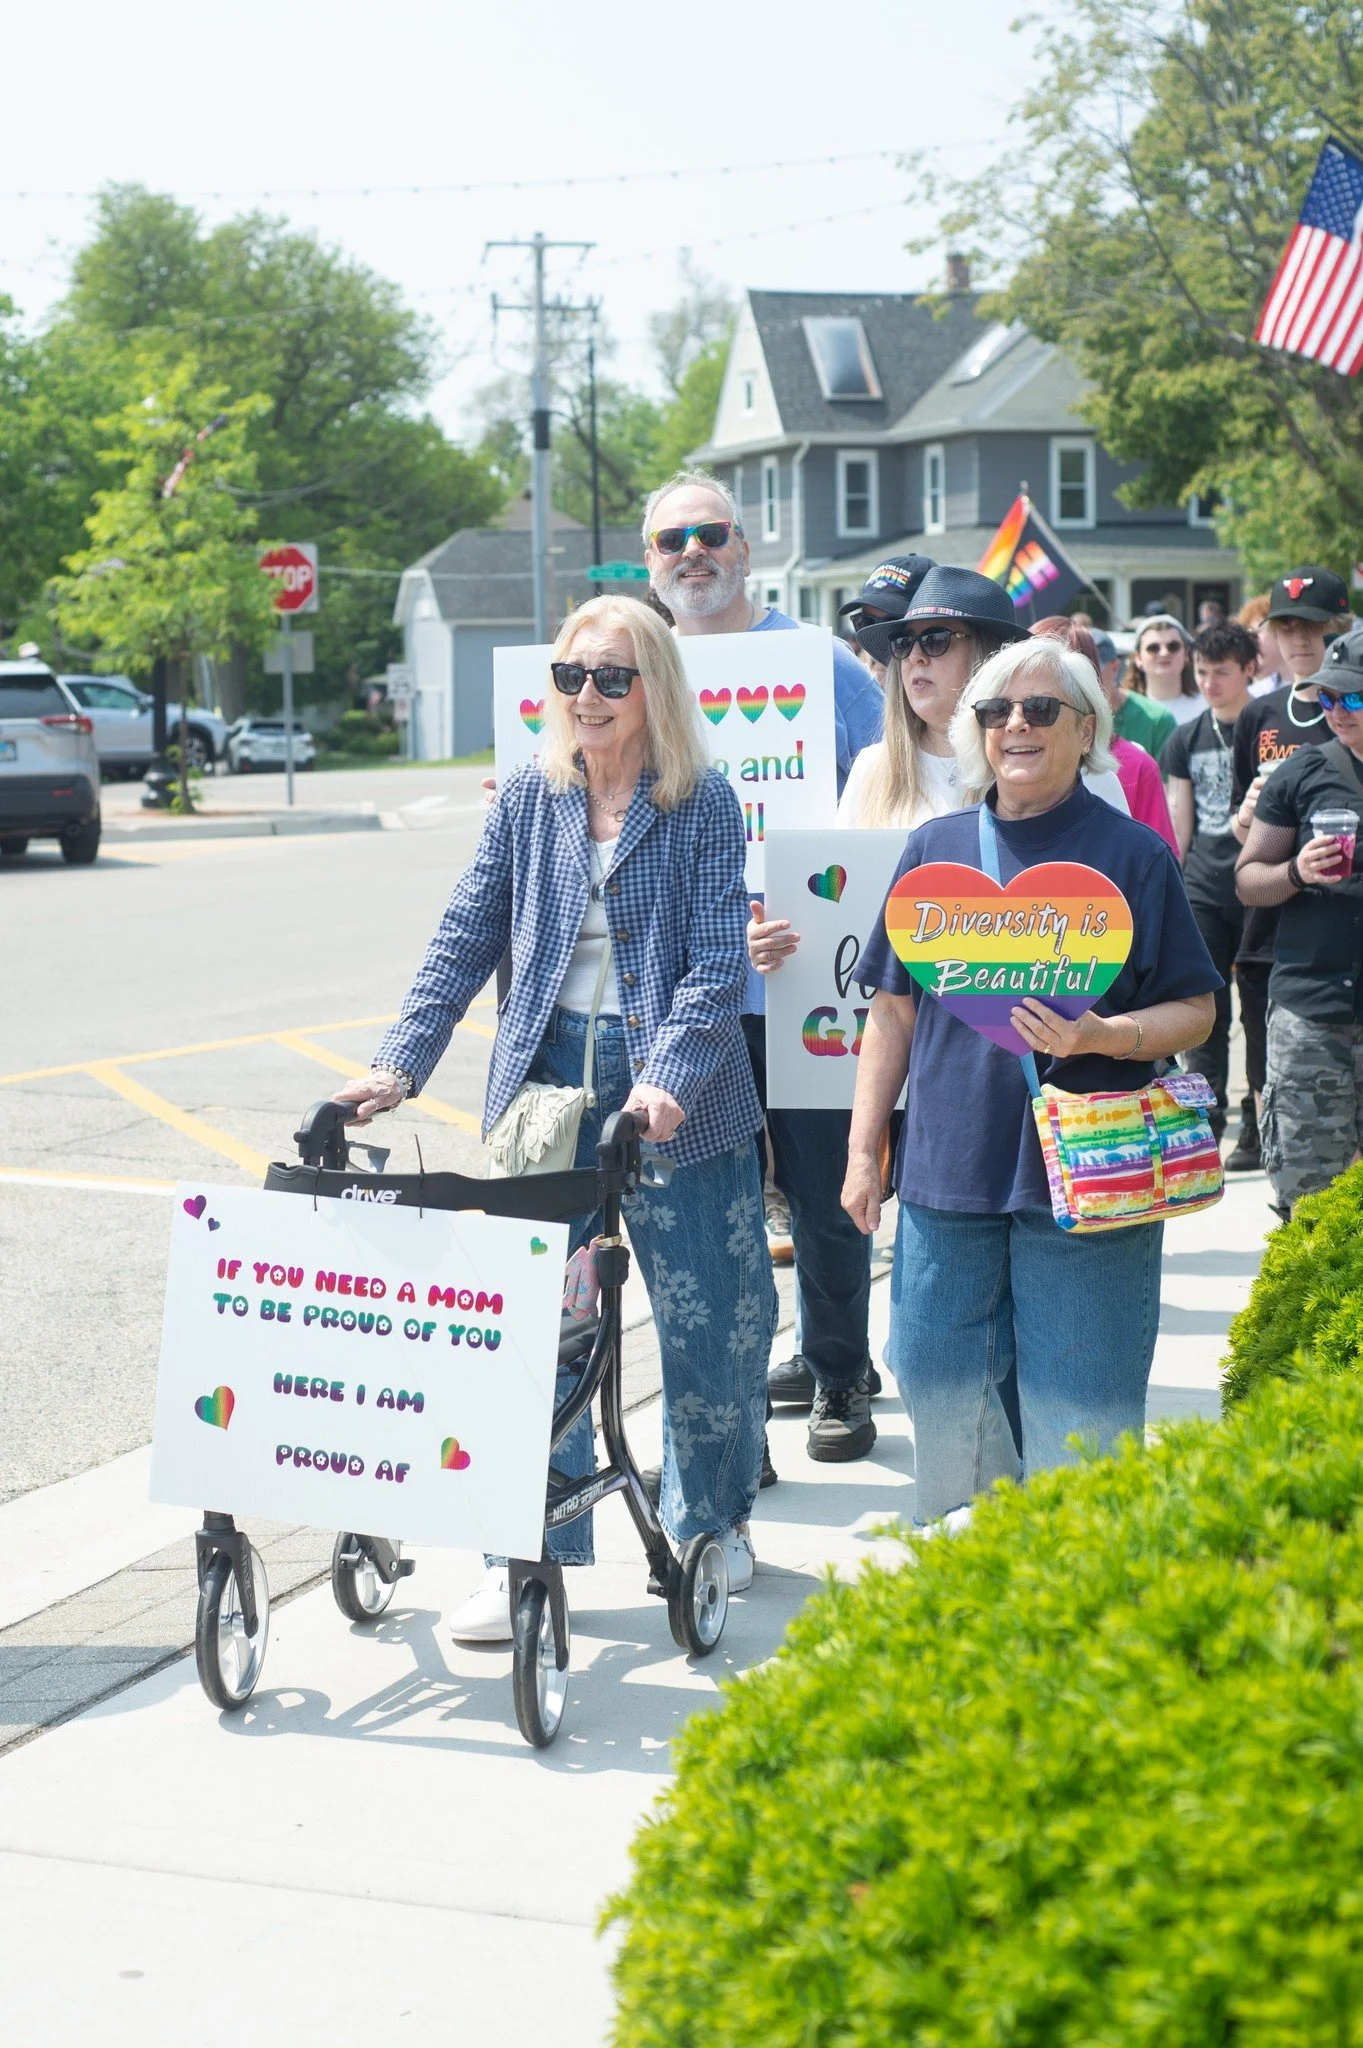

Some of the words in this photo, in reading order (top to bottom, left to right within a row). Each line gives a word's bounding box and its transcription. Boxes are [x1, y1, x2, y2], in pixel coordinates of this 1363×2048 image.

[1258, 729, 1279, 746] BE
[740, 740, 805, 783] and
[910, 900, 1069, 955] Diversity
[1080, 903, 1108, 937] is
[929, 955, 1098, 997] Beautiful
[217, 1258, 242, 1280] IF
[252, 1262, 304, 1289] YOU
[314, 1270, 387, 1299] NEED
[396, 1281, 417, 1304] A
[427, 1284, 504, 1315] MOM
[213, 1292, 249, 1317] TO
[260, 1299, 292, 1323] BE
[303, 1304, 393, 1336] PROUD
[403, 1317, 437, 1342] OF
[447, 1323, 502, 1351] YOU
[273, 1372, 346, 1403] HERE
[355, 1384, 366, 1406] I
[375, 1387, 426, 1414] AM
[275, 1443, 365, 1477] PROUD
[375, 1459, 411, 1484] AF
[552, 1494, 579, 1523] NITRO
